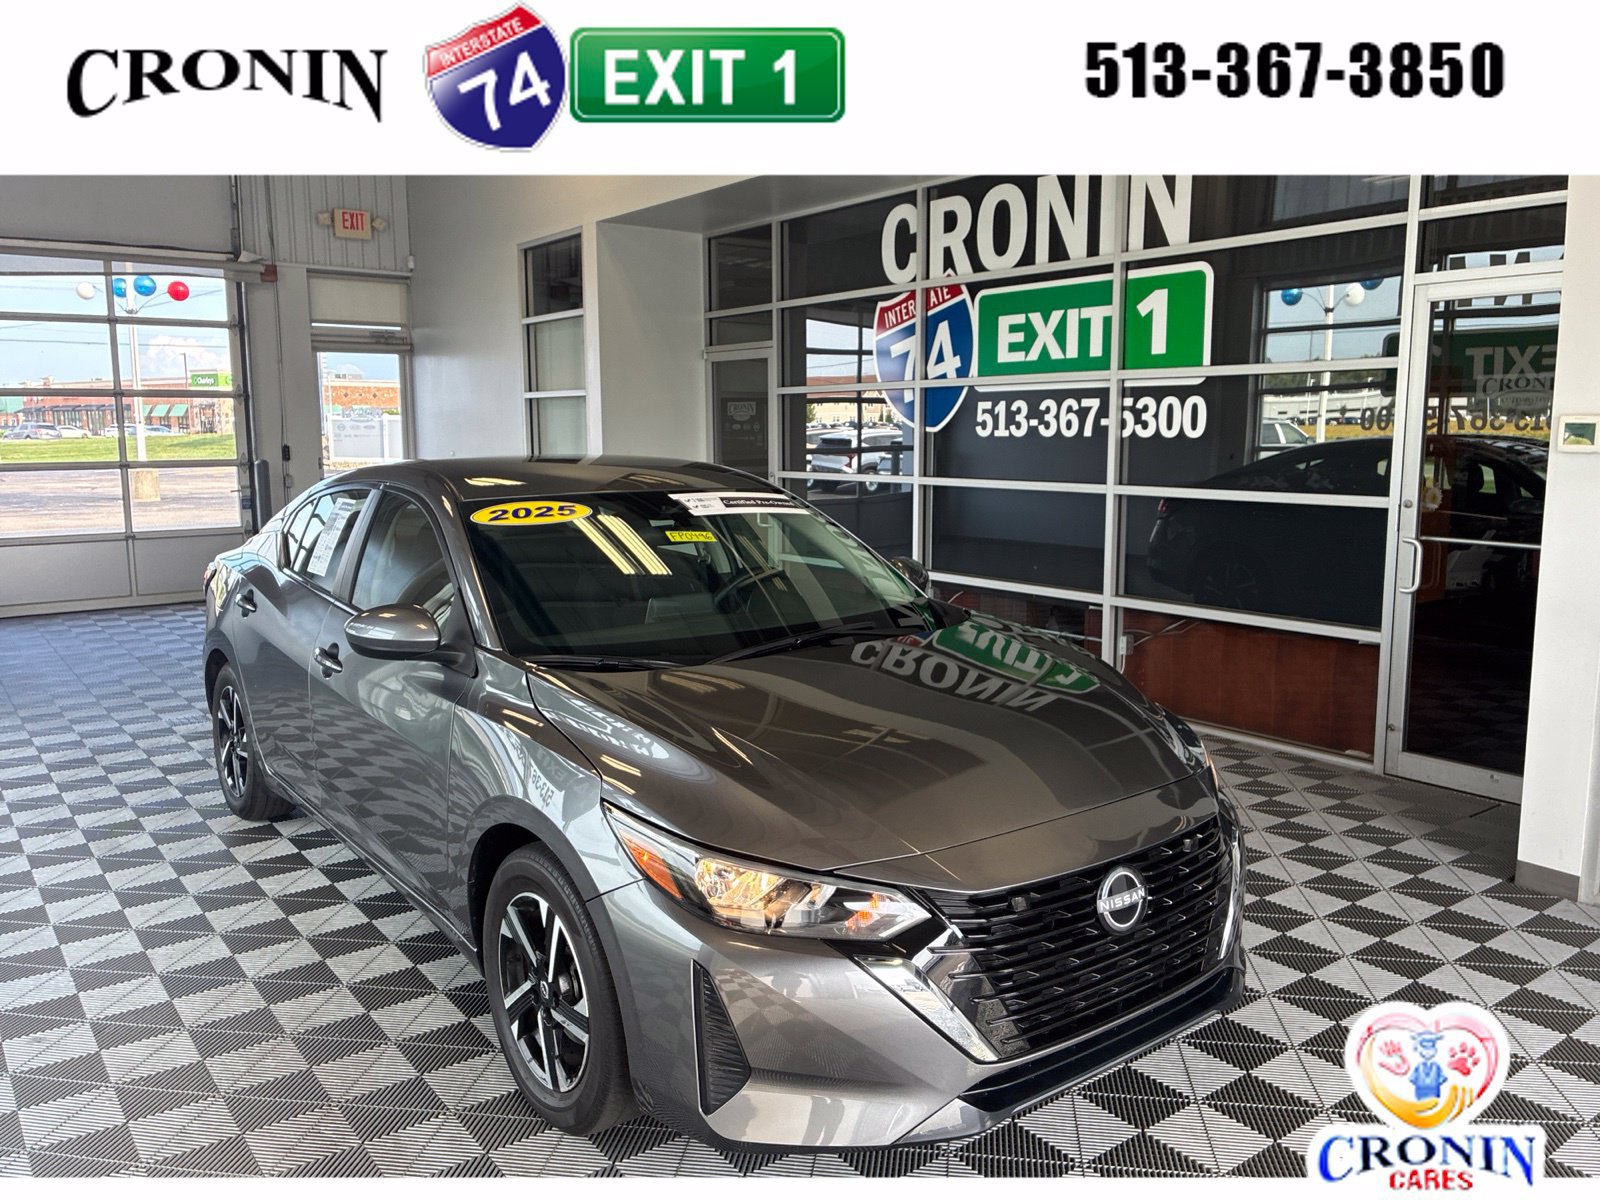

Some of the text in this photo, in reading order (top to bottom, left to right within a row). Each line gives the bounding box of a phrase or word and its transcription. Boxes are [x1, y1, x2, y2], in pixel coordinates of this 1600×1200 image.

[341, 211, 366, 231] EXIT
[881, 175, 1193, 285] CRONIN
[884, 286, 951, 329] INTERATE
[997, 288, 1169, 363] EXIT 1
[890, 320, 962, 404] 74
[975, 395, 1207, 439] 513-367-5300
[488, 503, 576, 521] 2025
[1099, 887, 1146, 911] NISSAN
